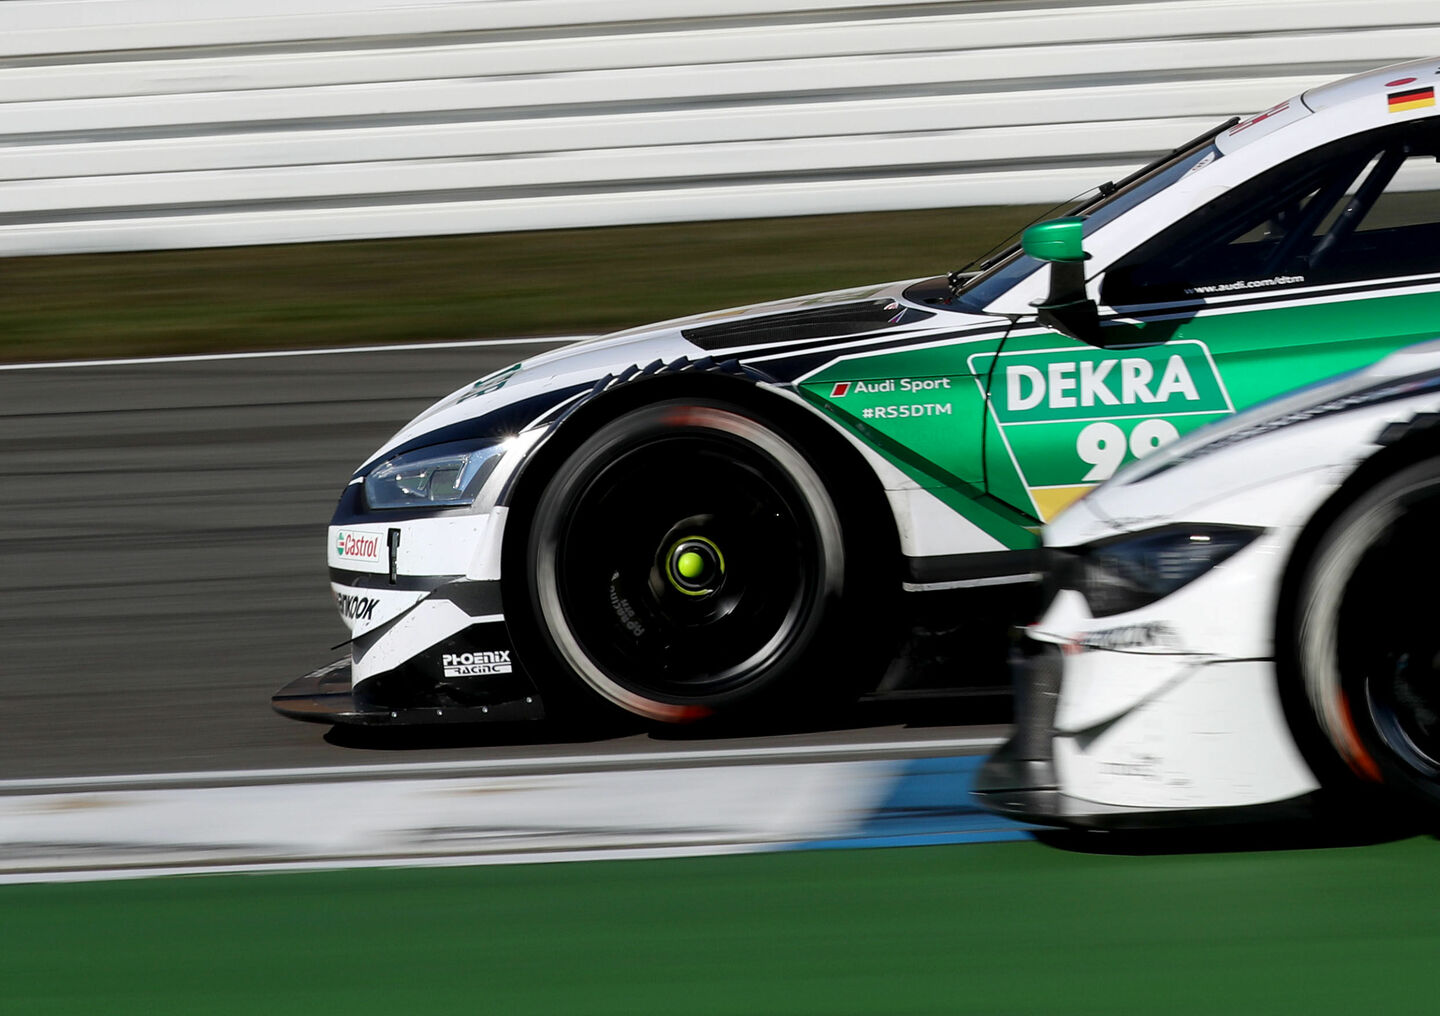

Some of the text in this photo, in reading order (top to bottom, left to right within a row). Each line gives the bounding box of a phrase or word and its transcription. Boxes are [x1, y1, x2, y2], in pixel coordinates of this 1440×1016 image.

[854, 376, 951, 395] Audi Sport
[1006, 354, 1200, 412] DEKRA
[861, 402, 953, 420] #RS5DTM
[344, 533, 378, 558] Castrol
